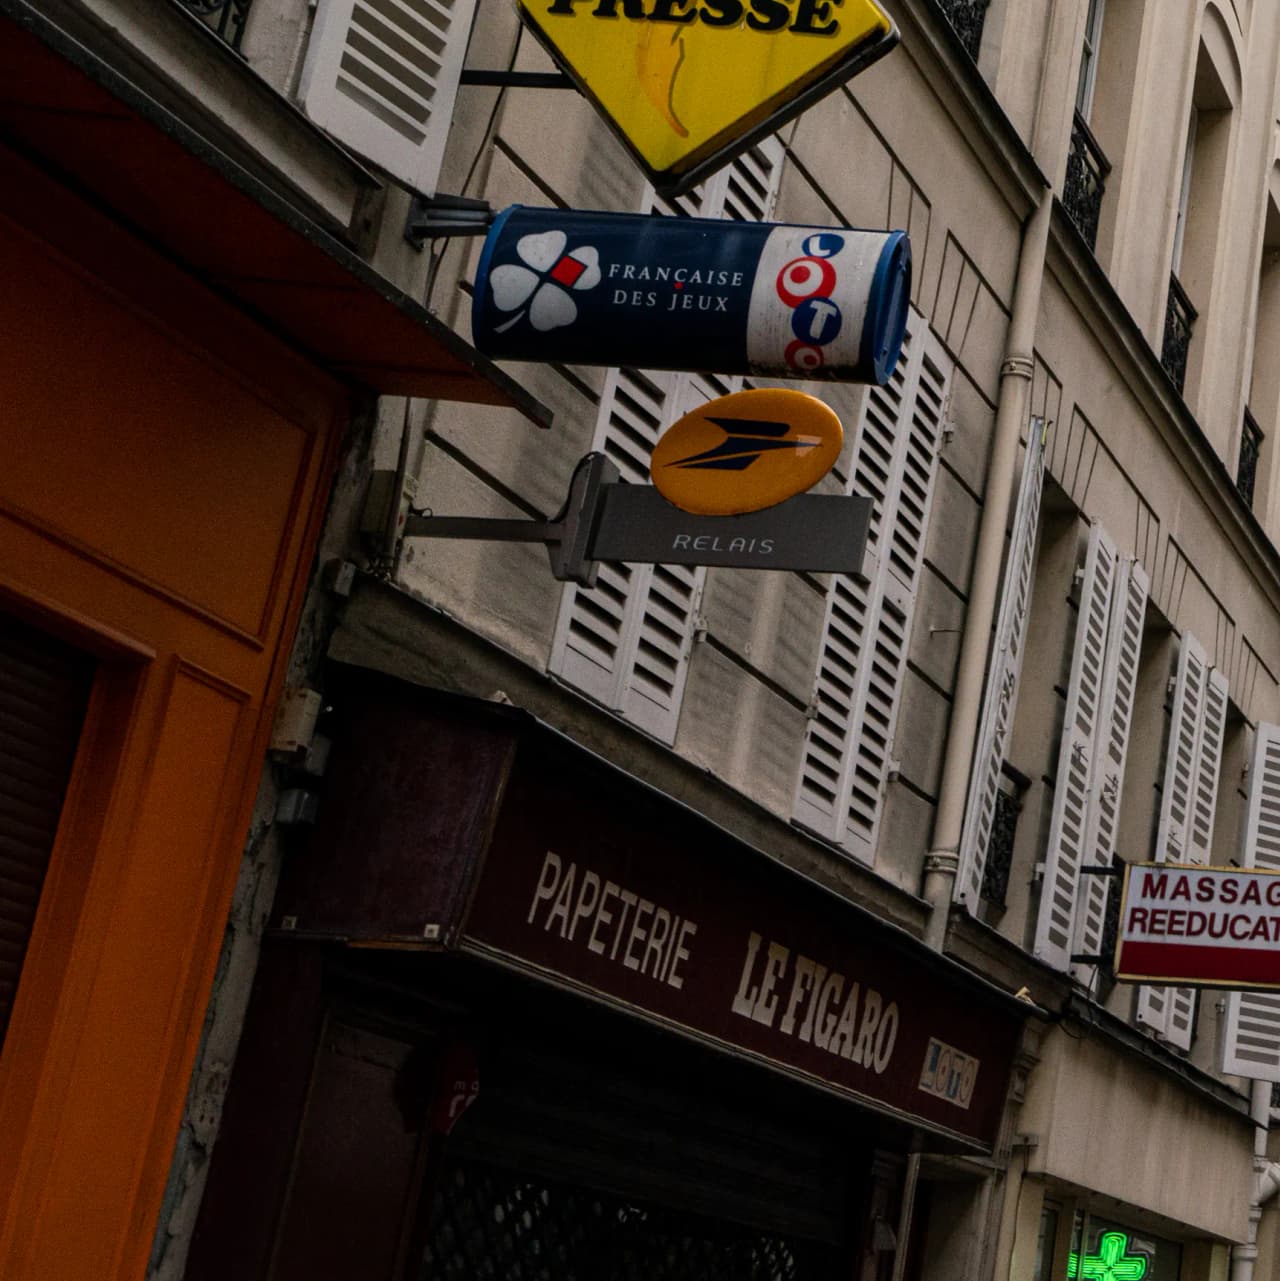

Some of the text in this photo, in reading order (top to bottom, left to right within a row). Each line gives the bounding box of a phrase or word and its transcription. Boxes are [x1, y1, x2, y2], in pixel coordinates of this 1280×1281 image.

[607, 263, 745, 289] FRANÇAISE
[612, 289, 729, 313] DES JEUX
[672, 533, 776, 555] RELAIS
[527, 850, 699, 990] PAPETERIE
[731, 930, 900, 1075] LE FIGARO
[920, 1040, 976, 1104] LOTO
